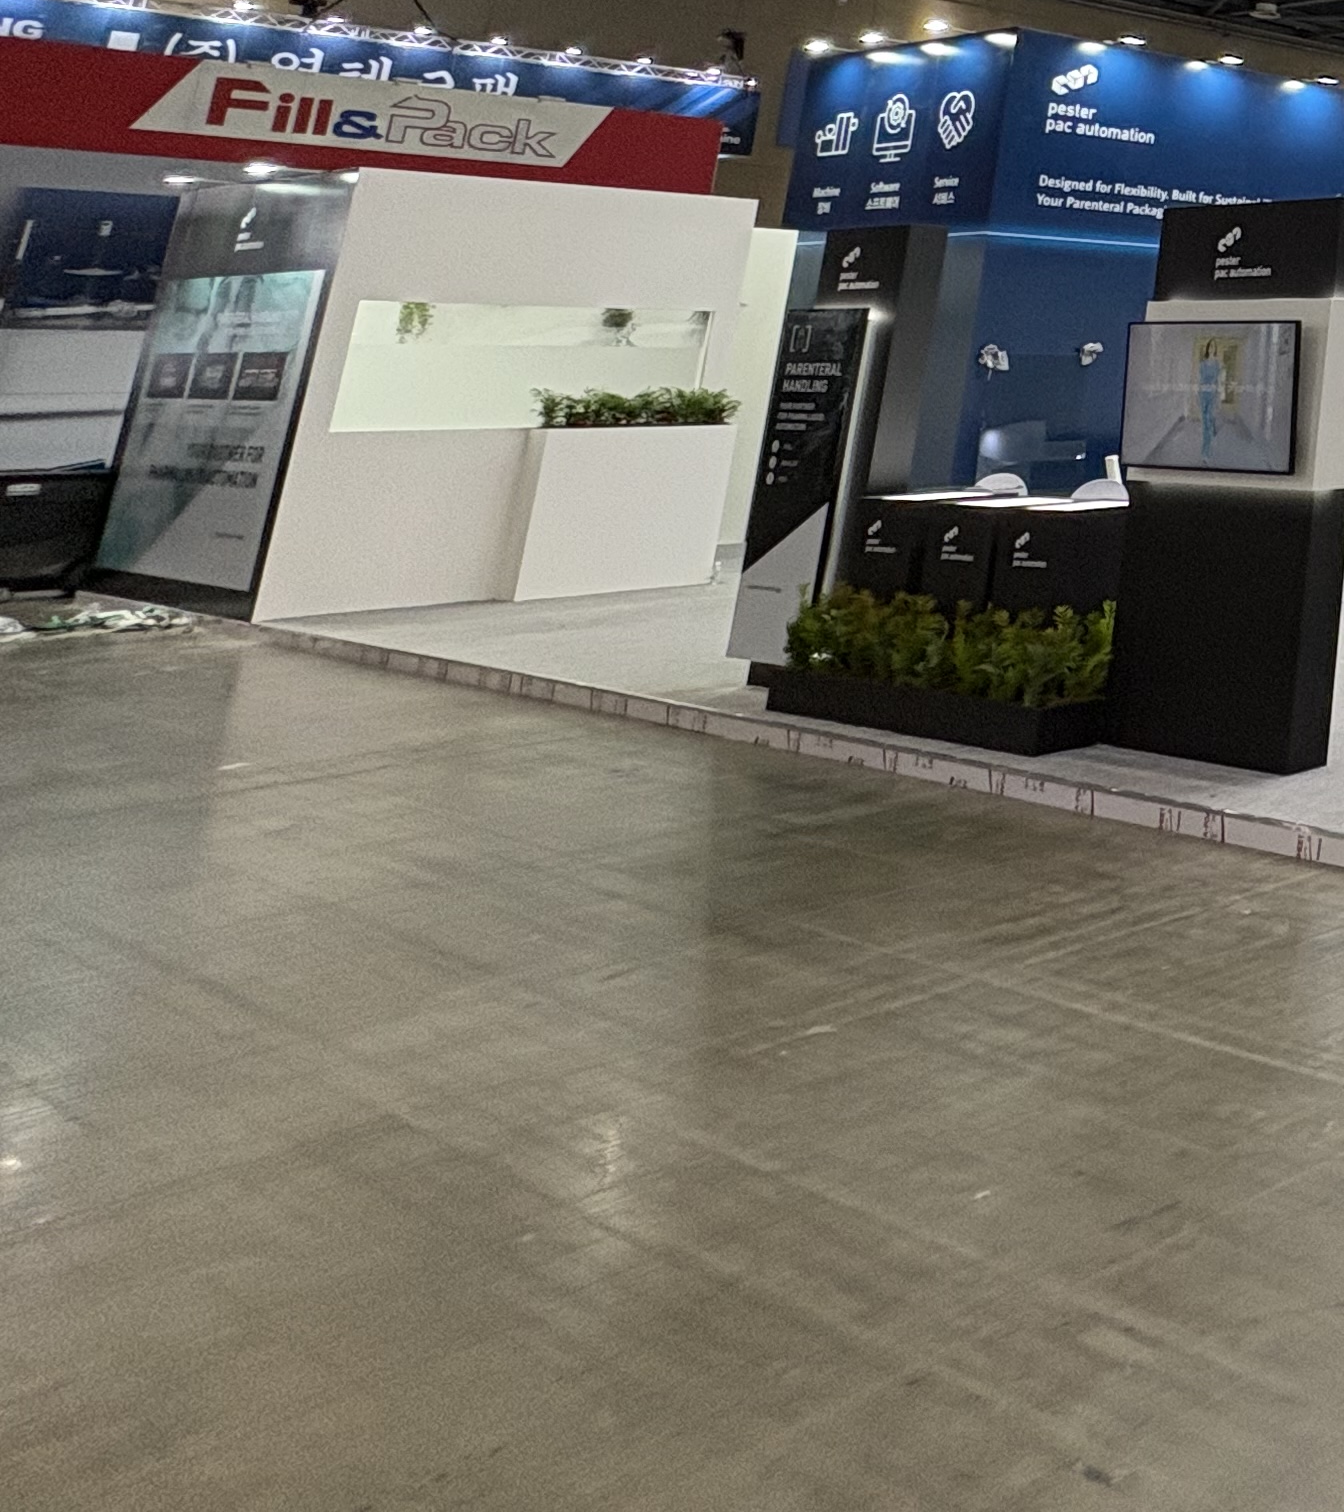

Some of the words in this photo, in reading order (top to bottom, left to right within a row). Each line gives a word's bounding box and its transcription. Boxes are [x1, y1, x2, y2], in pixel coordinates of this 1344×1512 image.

[206, 77, 556, 158] Fill&Pack
[1047, 102, 1097, 120] pester
[1045, 118, 1072, 133] pac
[1076, 120, 1155, 145] automation
[1038, 174, 1093, 192] Designed
[1095, 180, 1112, 193] for
[1172, 188, 1197, 203] Built
[1198, 191, 1214, 204] for
[1037, 193, 1063, 207] Your
[1066, 197, 1124, 213] Parenteral
[1126, 202, 1165, 220] Packag
[1215, 255, 1241, 268] pester
[1214, 268, 1228, 280] pac
[1229, 266, 1271, 278] automation
[785, 363, 843, 377] PARENTERAL
[783, 379, 829, 393] HANDLING
